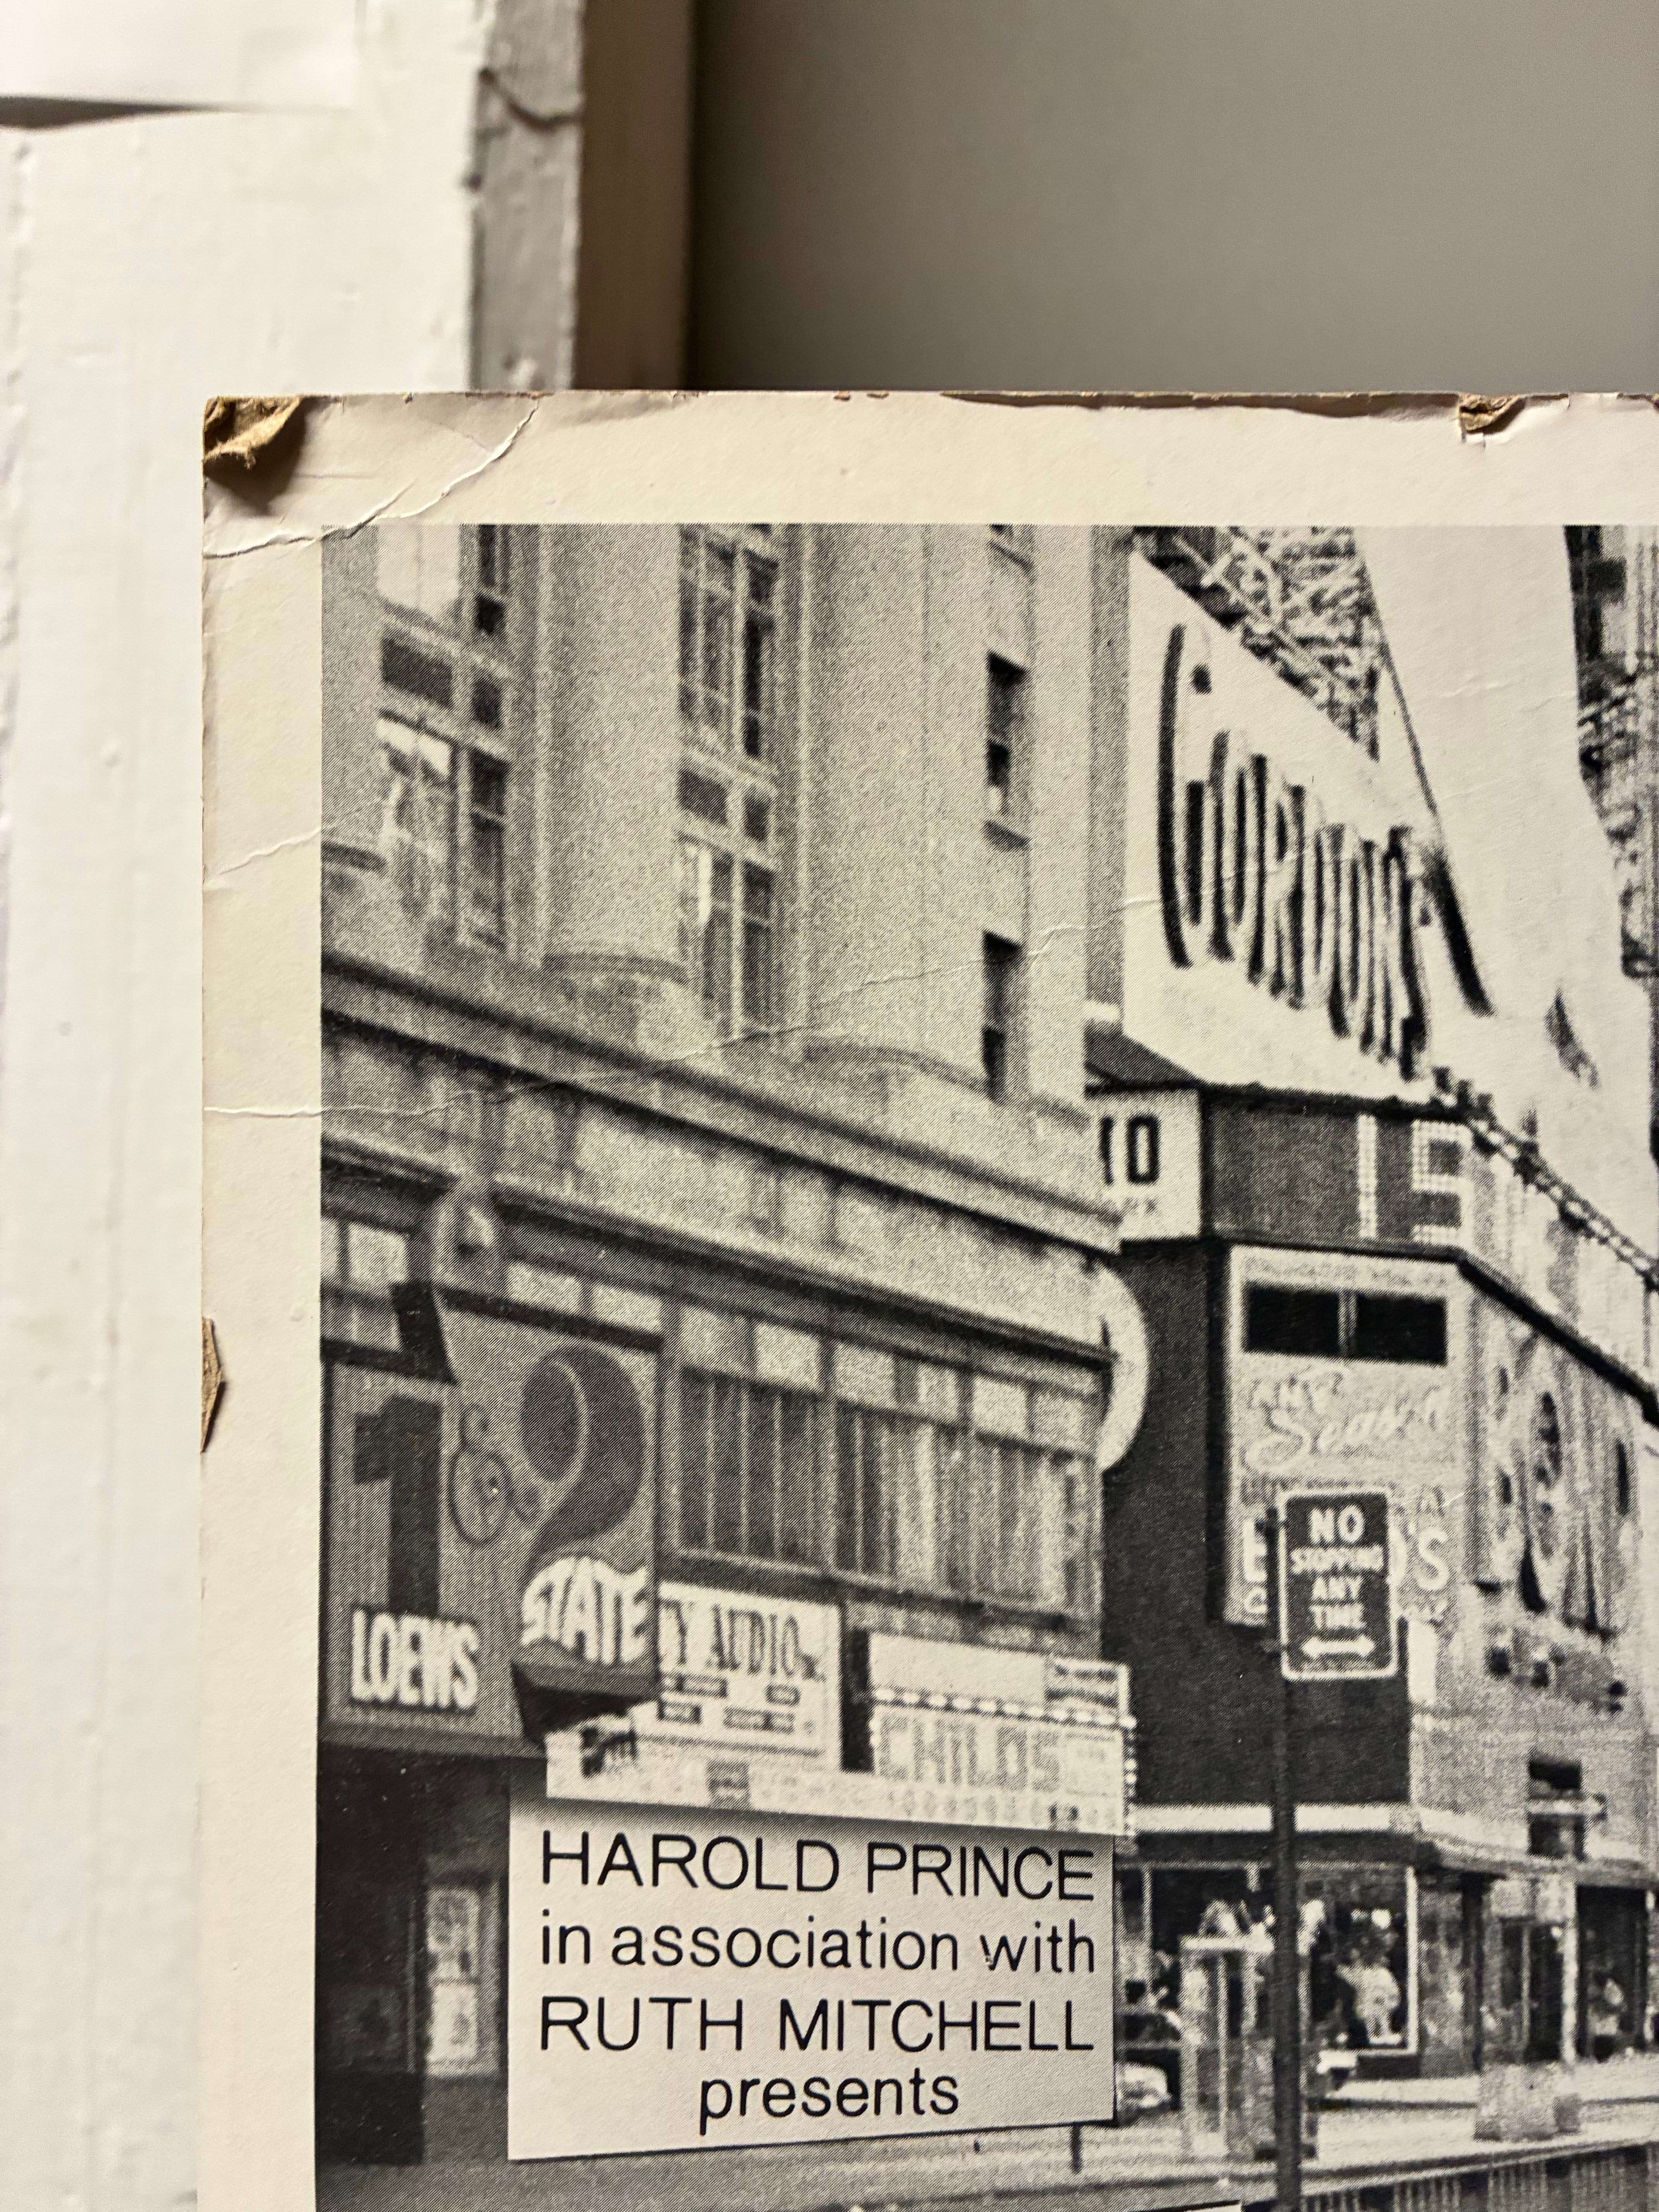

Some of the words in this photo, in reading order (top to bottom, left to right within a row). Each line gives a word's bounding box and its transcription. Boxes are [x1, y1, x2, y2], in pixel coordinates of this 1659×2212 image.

[1308, 1504, 1367, 1544] NO
[520, 1556, 654, 1665] STATE
[1311, 1575, 1363, 1601] ANY
[542, 1831, 839, 1893] HAROLD
[867, 1842, 1094, 1901] PRINCE
[541, 1909, 591, 1965] in
[611, 1916, 958, 1970] association
[980, 1919, 1094, 1973] with
[541, 1996, 743, 2051] RUTH
[779, 1999, 1094, 2052] MITCHELL
[700, 2068, 959, 2135] presents
